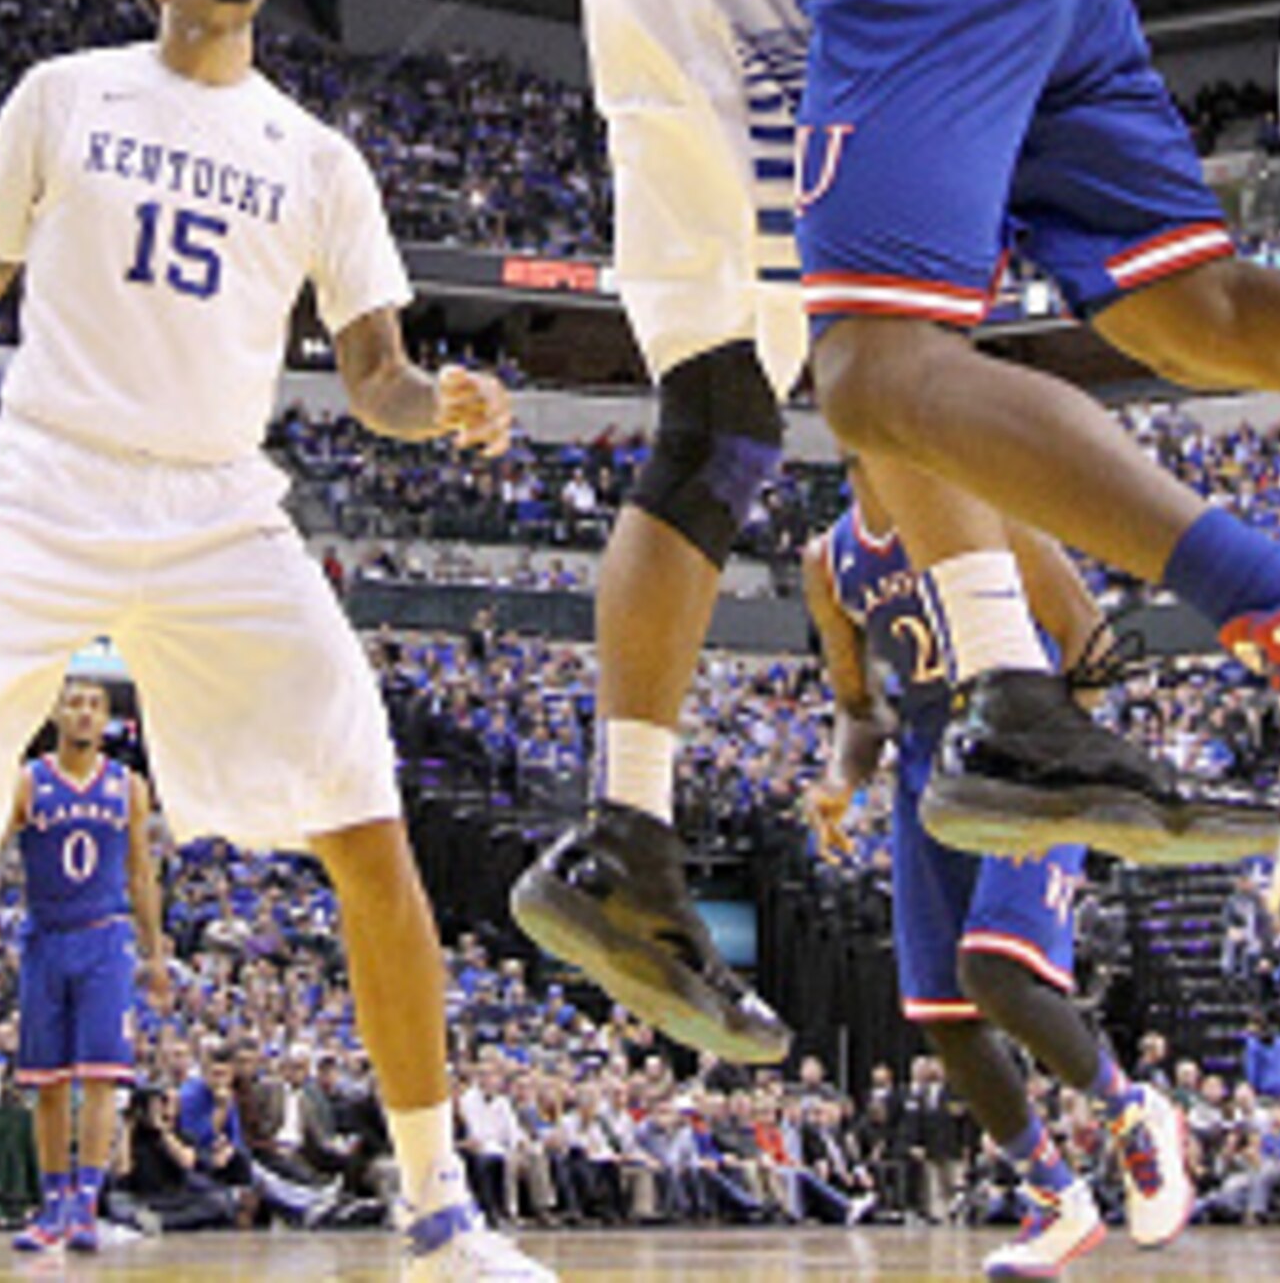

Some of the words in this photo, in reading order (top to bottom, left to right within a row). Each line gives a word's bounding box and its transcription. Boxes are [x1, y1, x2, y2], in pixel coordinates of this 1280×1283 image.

[82, 131, 287, 225] KENTUCKY
[123, 201, 229, 302] 15
[62, 829, 99, 883] 0
